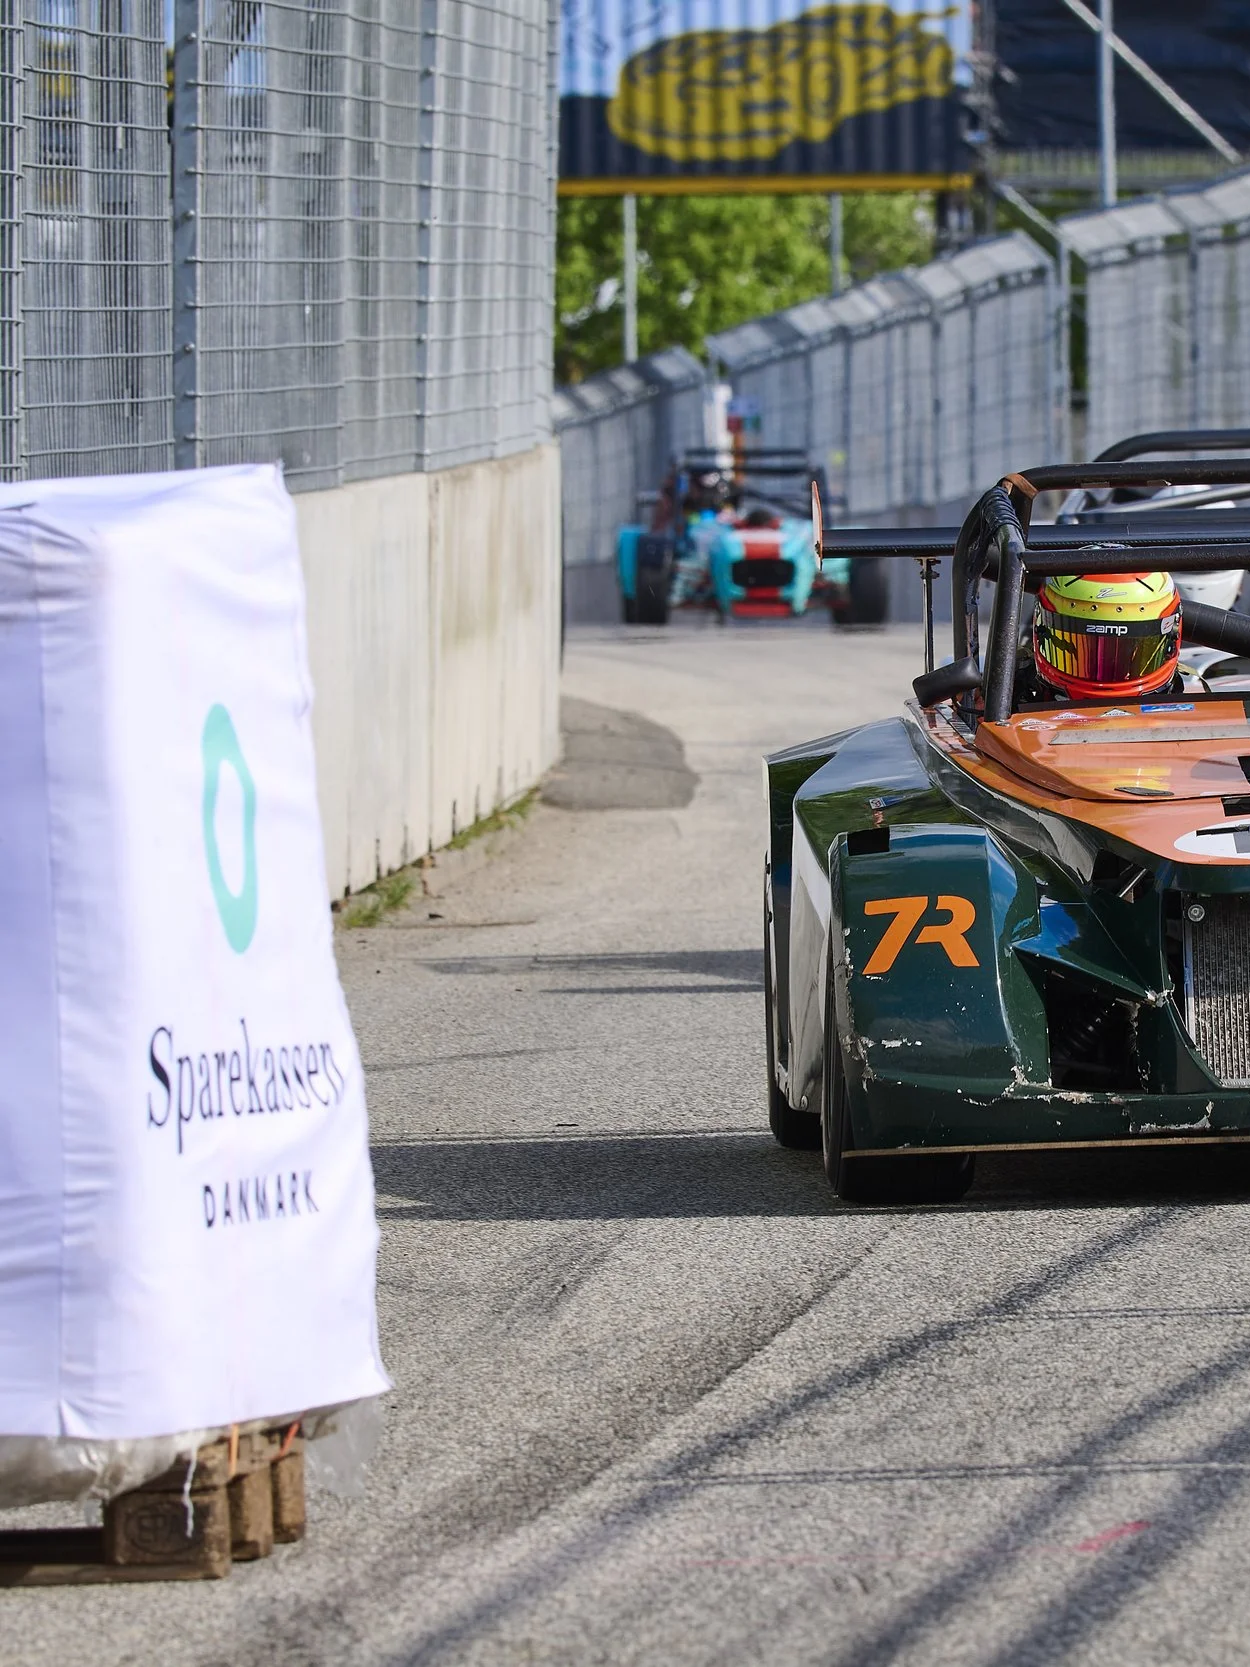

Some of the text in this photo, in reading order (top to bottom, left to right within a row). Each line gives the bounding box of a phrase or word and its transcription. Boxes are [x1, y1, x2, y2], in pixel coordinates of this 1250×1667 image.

[1085, 624, 1128, 637] zamp
[862, 894, 981, 976] 7R
[147, 1017, 345, 1154] Sparekassen
[203, 1170, 320, 1229] DANMARK
